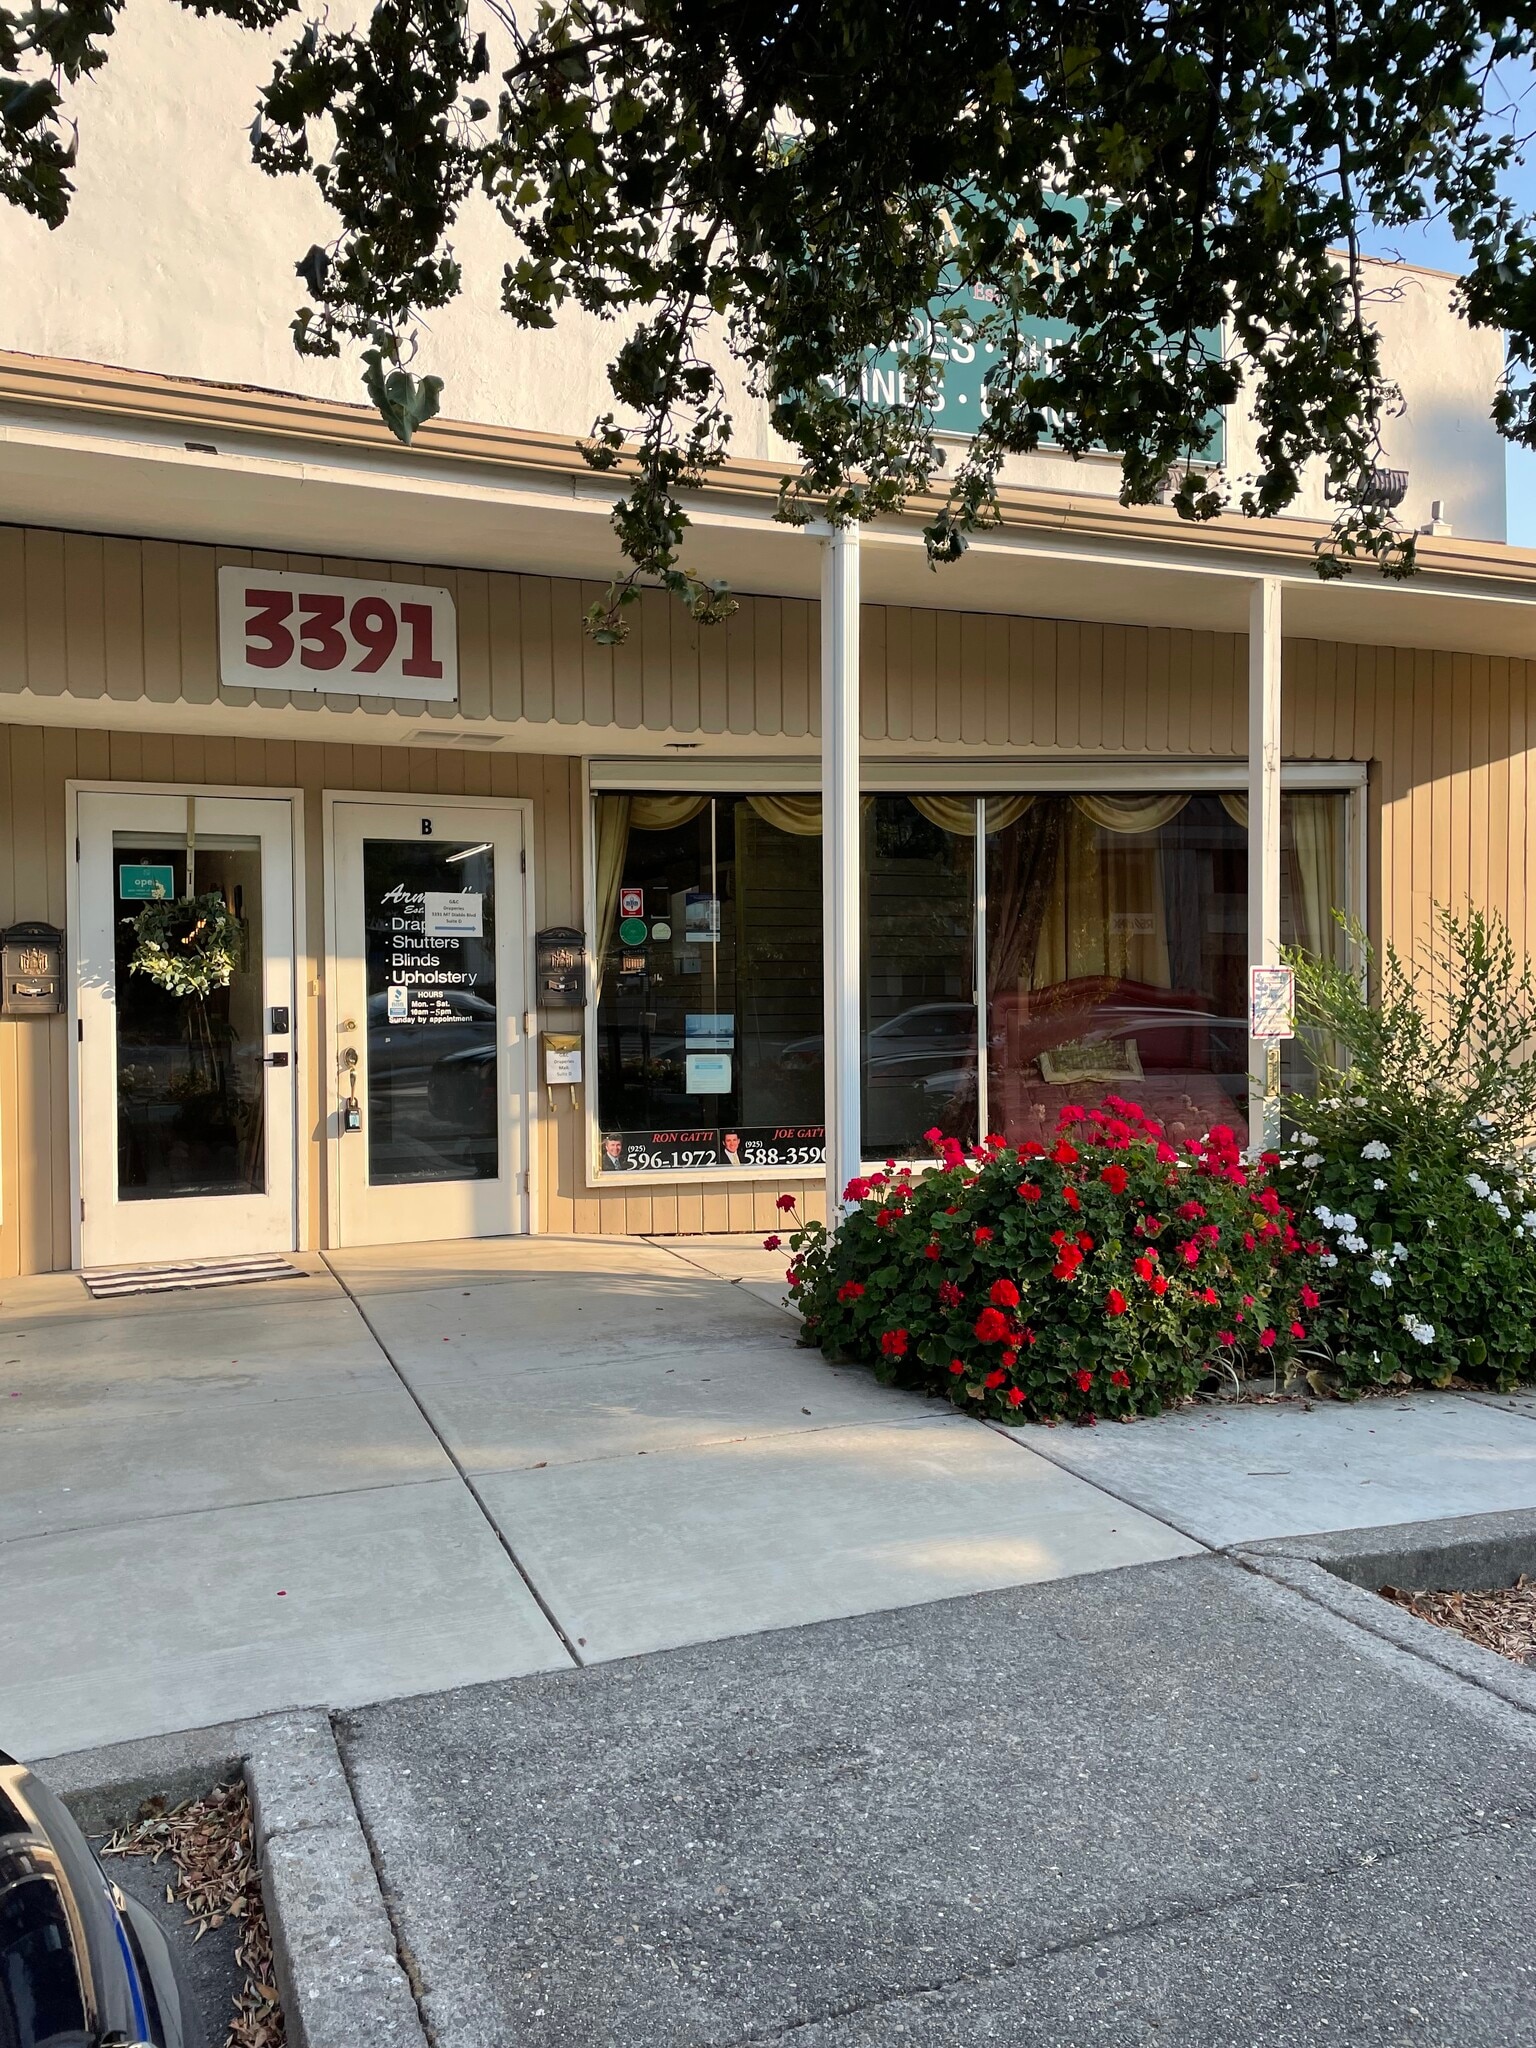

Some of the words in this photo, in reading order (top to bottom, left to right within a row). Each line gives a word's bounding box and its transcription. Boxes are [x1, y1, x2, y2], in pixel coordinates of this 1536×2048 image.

[245, 588, 443, 679] 3391
[421, 818, 433, 835] B
[392, 935, 460, 949] Shutters
[392, 953, 440, 967] Blinds
[392, 970, 478, 986] Upholstery
[417, 991, 444, 999] HOURS
[411, 1000, 429, 1008] Mon.
[388, 1016, 416, 1025] Sunday
[417, 1016, 427, 1024] by
[429, 1015, 473, 1024] appointment
[652, 1133, 679, 1143] RON
[680, 1131, 714, 1142] GATTI
[771, 1128, 795, 1140] JOE
[797, 1127, 826, 1138] GATT
[627, 1145, 646, 1153] (925)
[745, 1140, 763, 1149] (925)
[627, 1150, 717, 1171] 596-1972
